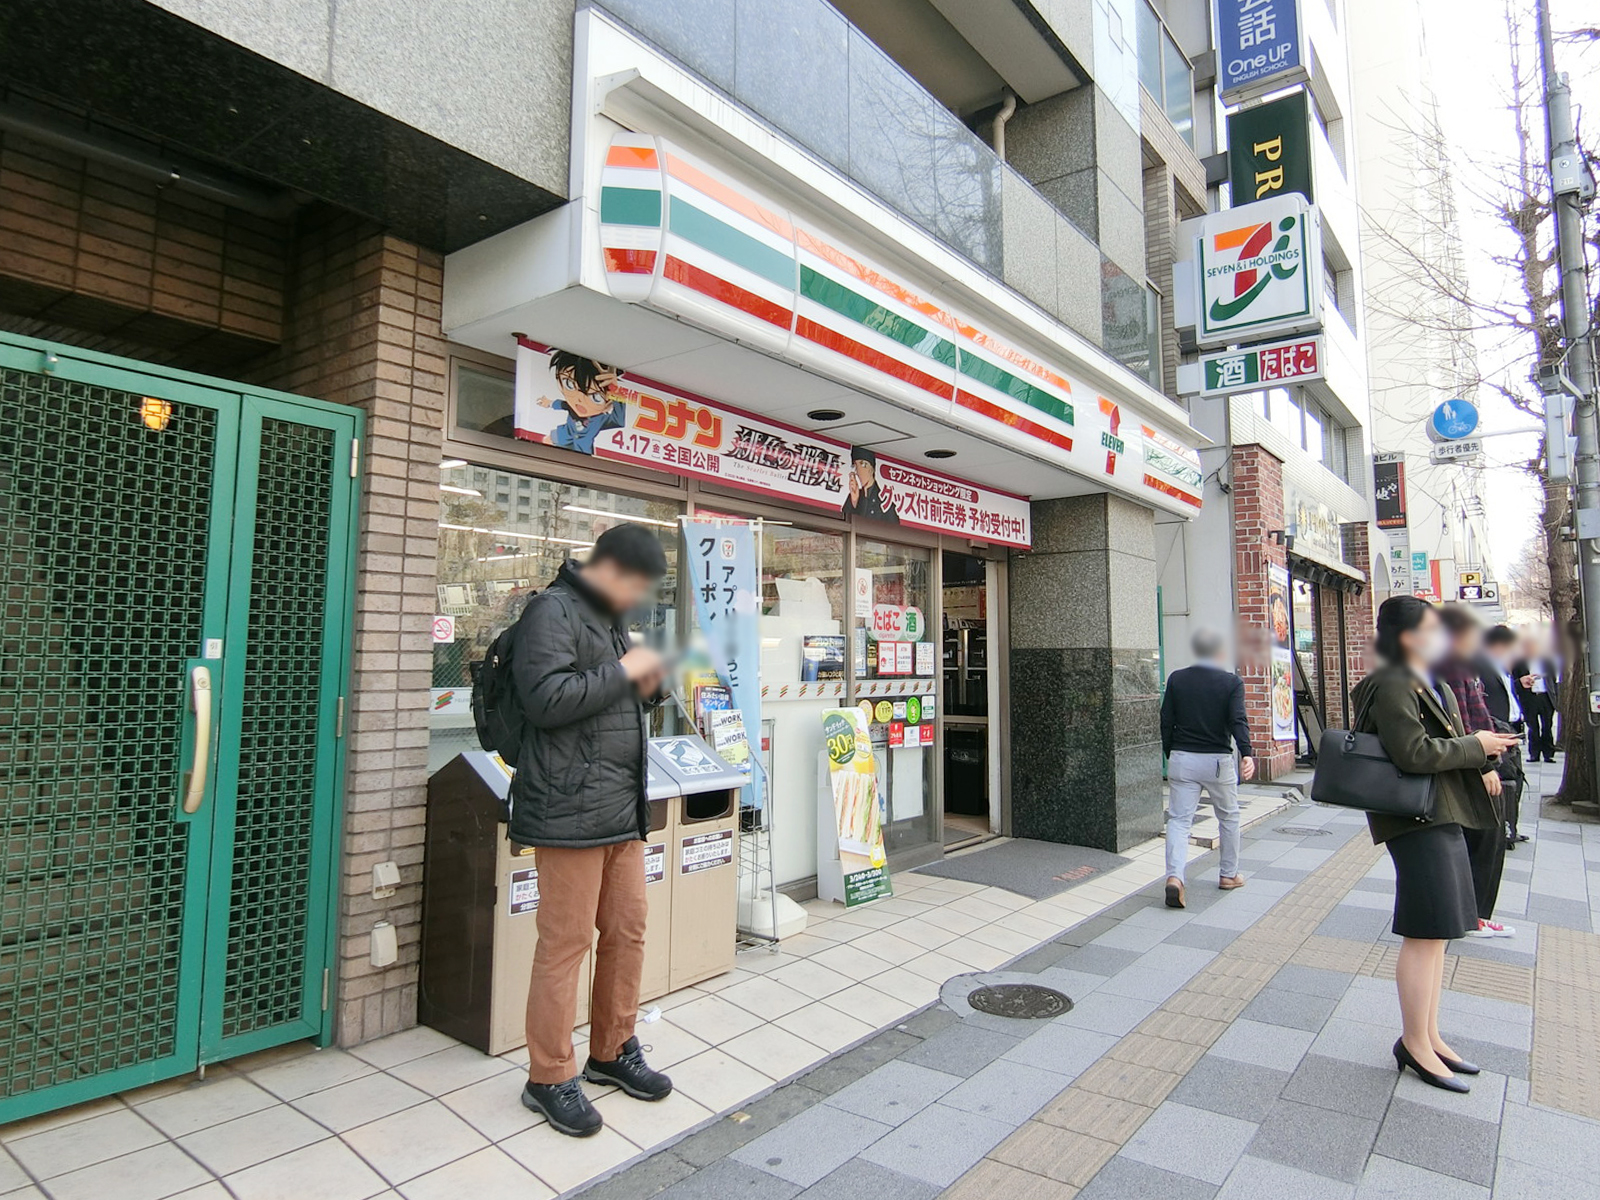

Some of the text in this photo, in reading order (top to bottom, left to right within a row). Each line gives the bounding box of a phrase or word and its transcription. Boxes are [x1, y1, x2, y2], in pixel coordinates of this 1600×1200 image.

[1228, 42, 1292, 76] One UP
[1232, 60, 1289, 84] ENGLISH SCHOOL
[1249, 249, 1300, 268] HOLDINGS
[1215, 345, 1317, 388] 酒 たばこ
[633, 393, 723, 451] コナン
[1101, 431, 1125, 455] ELEVEN
[1438, 442, 1480, 456] 歩行者優先
[662, 442, 720, 473] 全国公開
[888, 467, 973, 502] セブンネットショッピング限定
[879, 484, 967, 529] グッズ付前売券
[699, 537, 718, 621] クーポ
[1466, 574, 1475, 584] P
[873, 609, 917, 633] たばこ 酒
[720, 712, 742, 726] WORK
[724, 731, 747, 744] WORK
